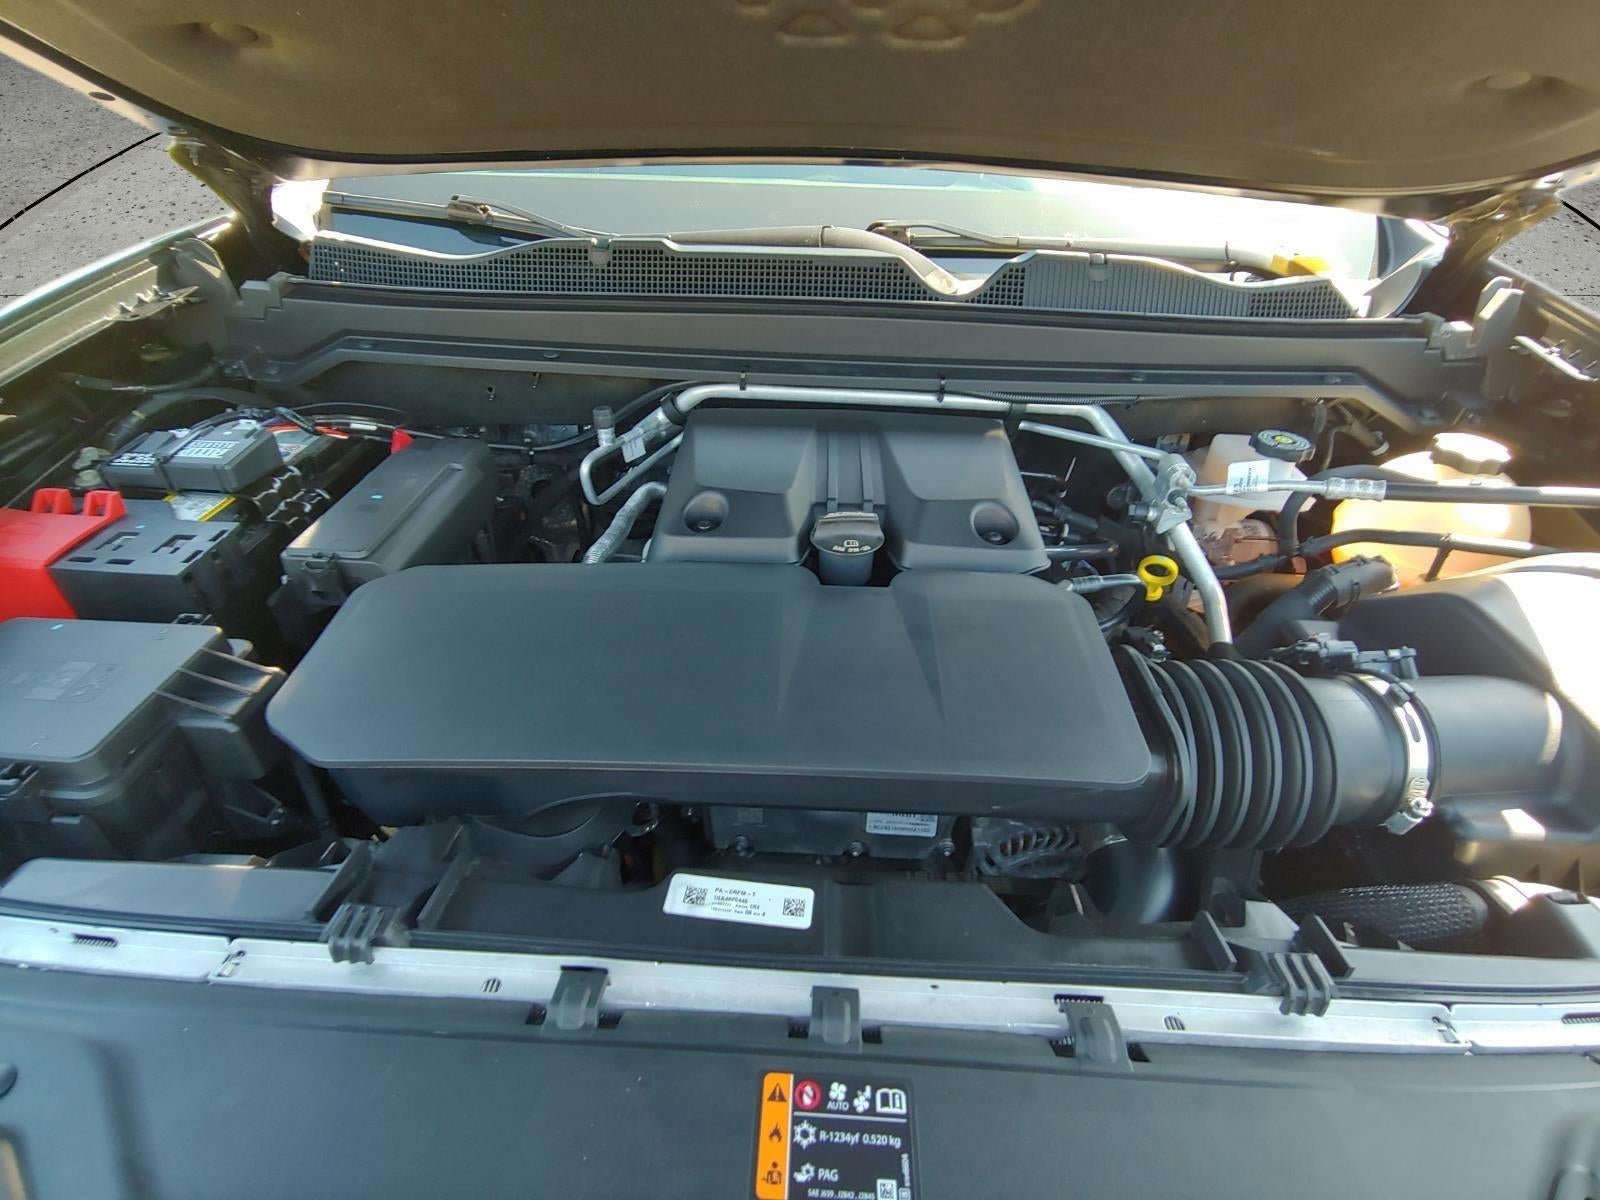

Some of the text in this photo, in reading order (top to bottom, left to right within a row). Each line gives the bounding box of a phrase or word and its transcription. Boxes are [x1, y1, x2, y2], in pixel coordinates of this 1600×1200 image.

[827, 1101, 850, 1111] AUTO
[819, 1130, 902, 1149] R-1234yf 0.520 kg
[818, 1168, 839, 1182] PAG
[807, 1188, 820, 1198] SAE
